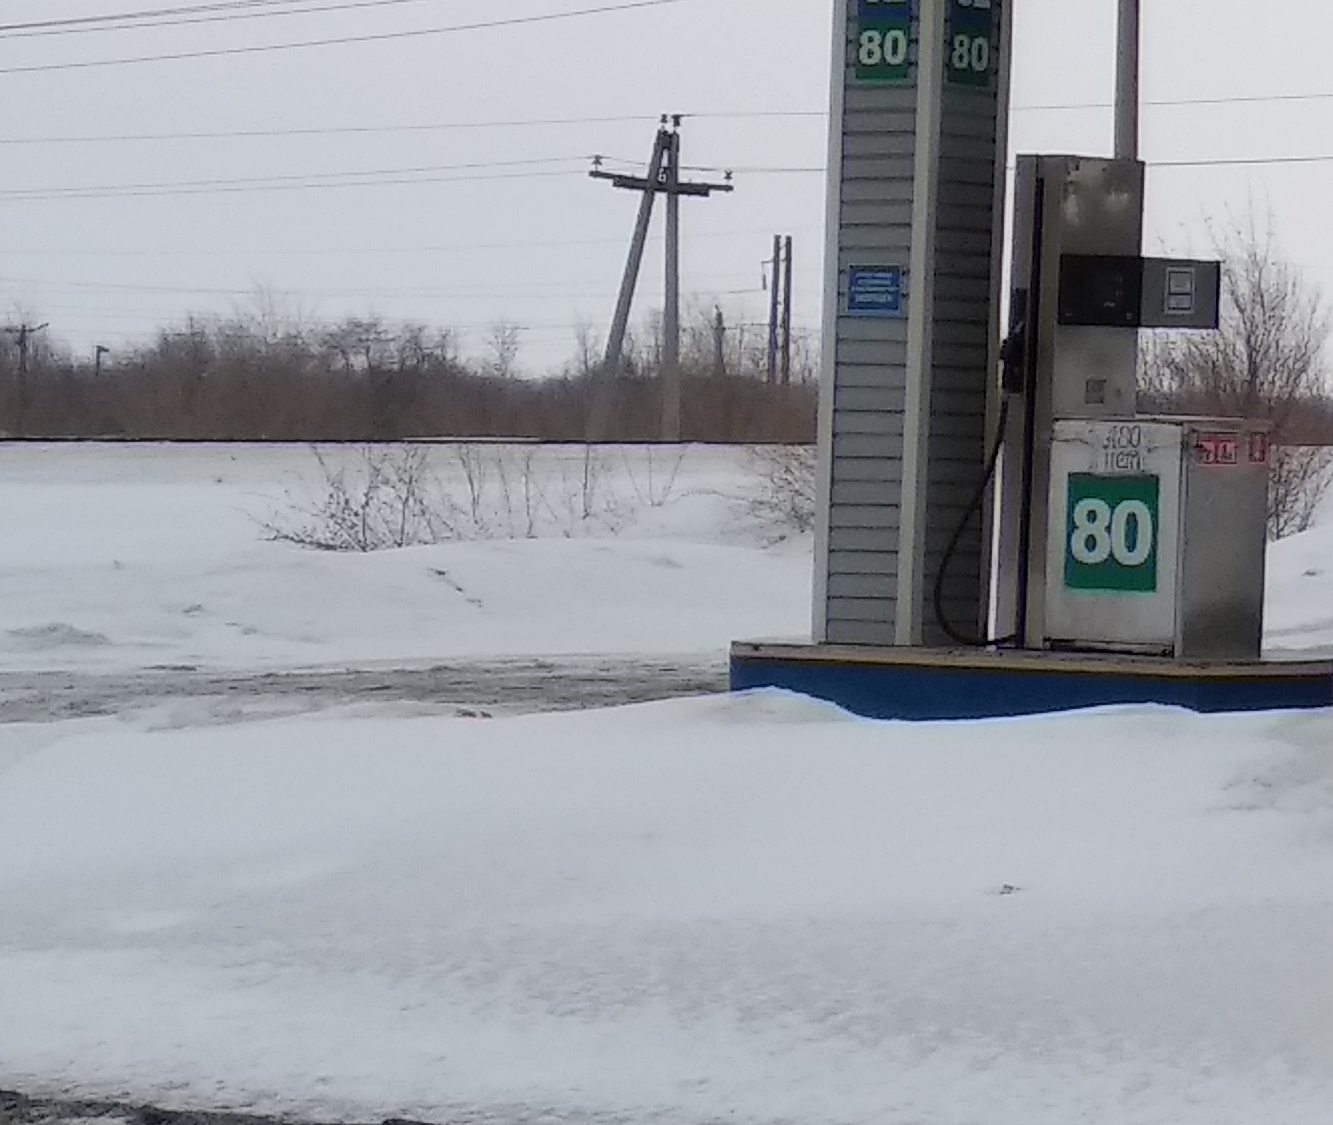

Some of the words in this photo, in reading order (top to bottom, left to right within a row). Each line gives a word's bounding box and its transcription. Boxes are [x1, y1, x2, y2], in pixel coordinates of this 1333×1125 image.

[858, 29, 908, 66] 80
[952, 33, 990, 72] 80
[1071, 497, 1152, 566] 80
